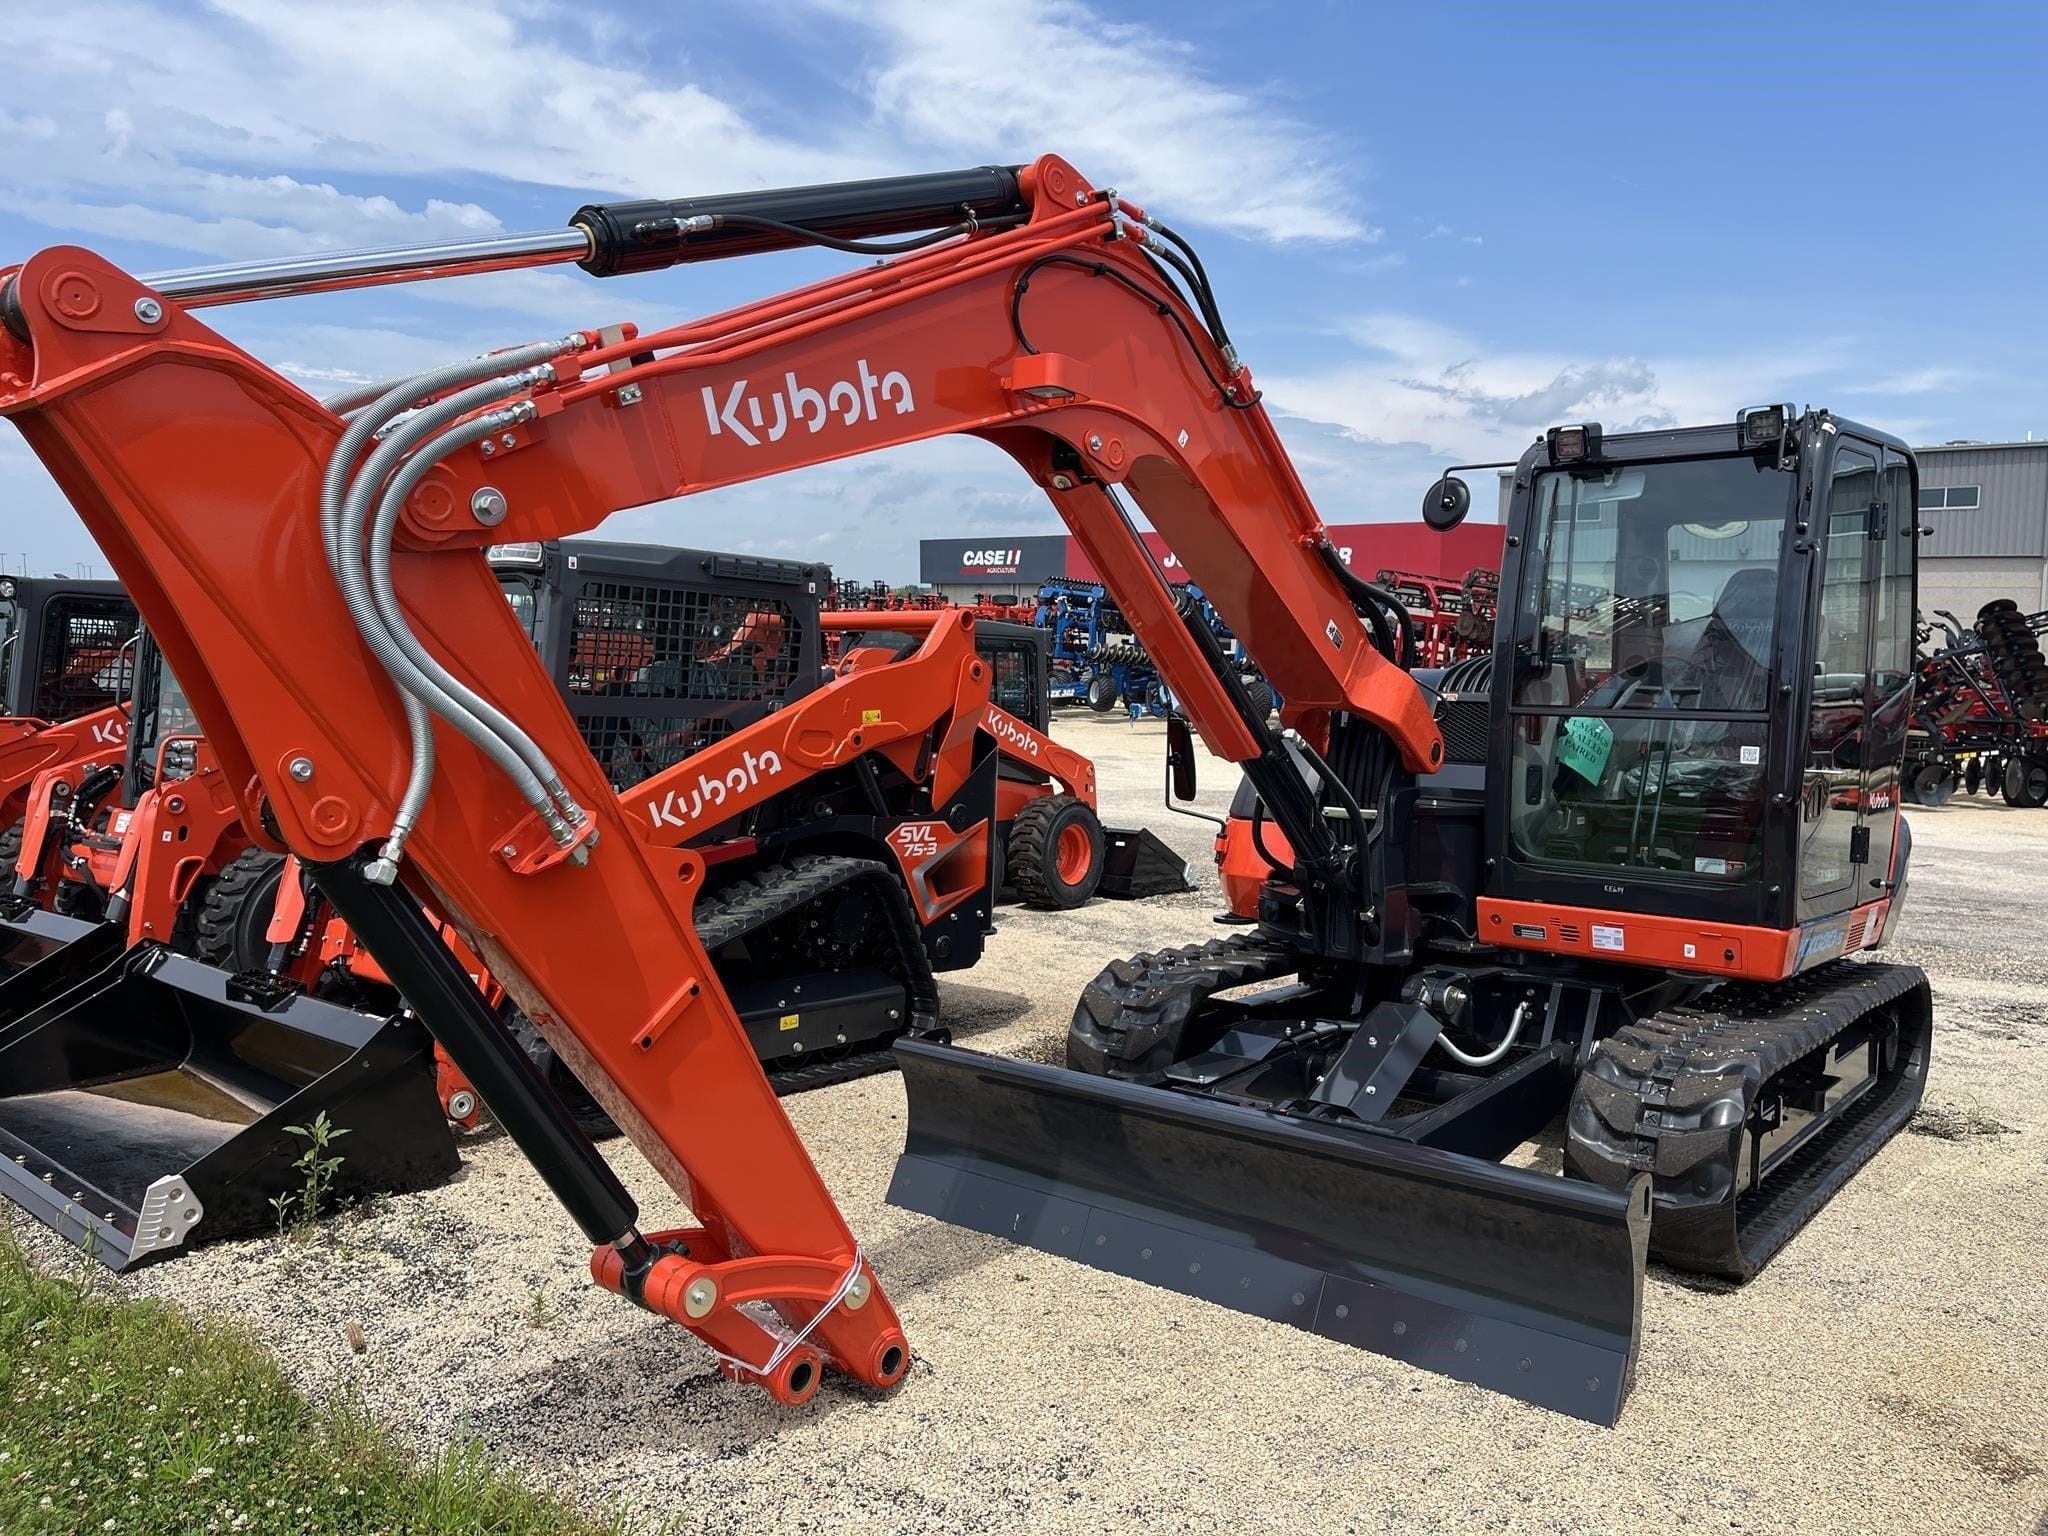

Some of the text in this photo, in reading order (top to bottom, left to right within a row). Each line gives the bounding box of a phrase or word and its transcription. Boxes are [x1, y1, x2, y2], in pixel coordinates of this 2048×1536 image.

[701, 359, 915, 447] Kubota
[962, 550, 1006, 566] CASE
[1163, 547, 1353, 568] J R
[988, 709, 1038, 757] Kubota
[648, 750, 782, 828] Kubota
[1869, 791, 1889, 809] Kubota
[897, 826, 936, 843] SVL
[903, 842, 938, 857] 75-3
